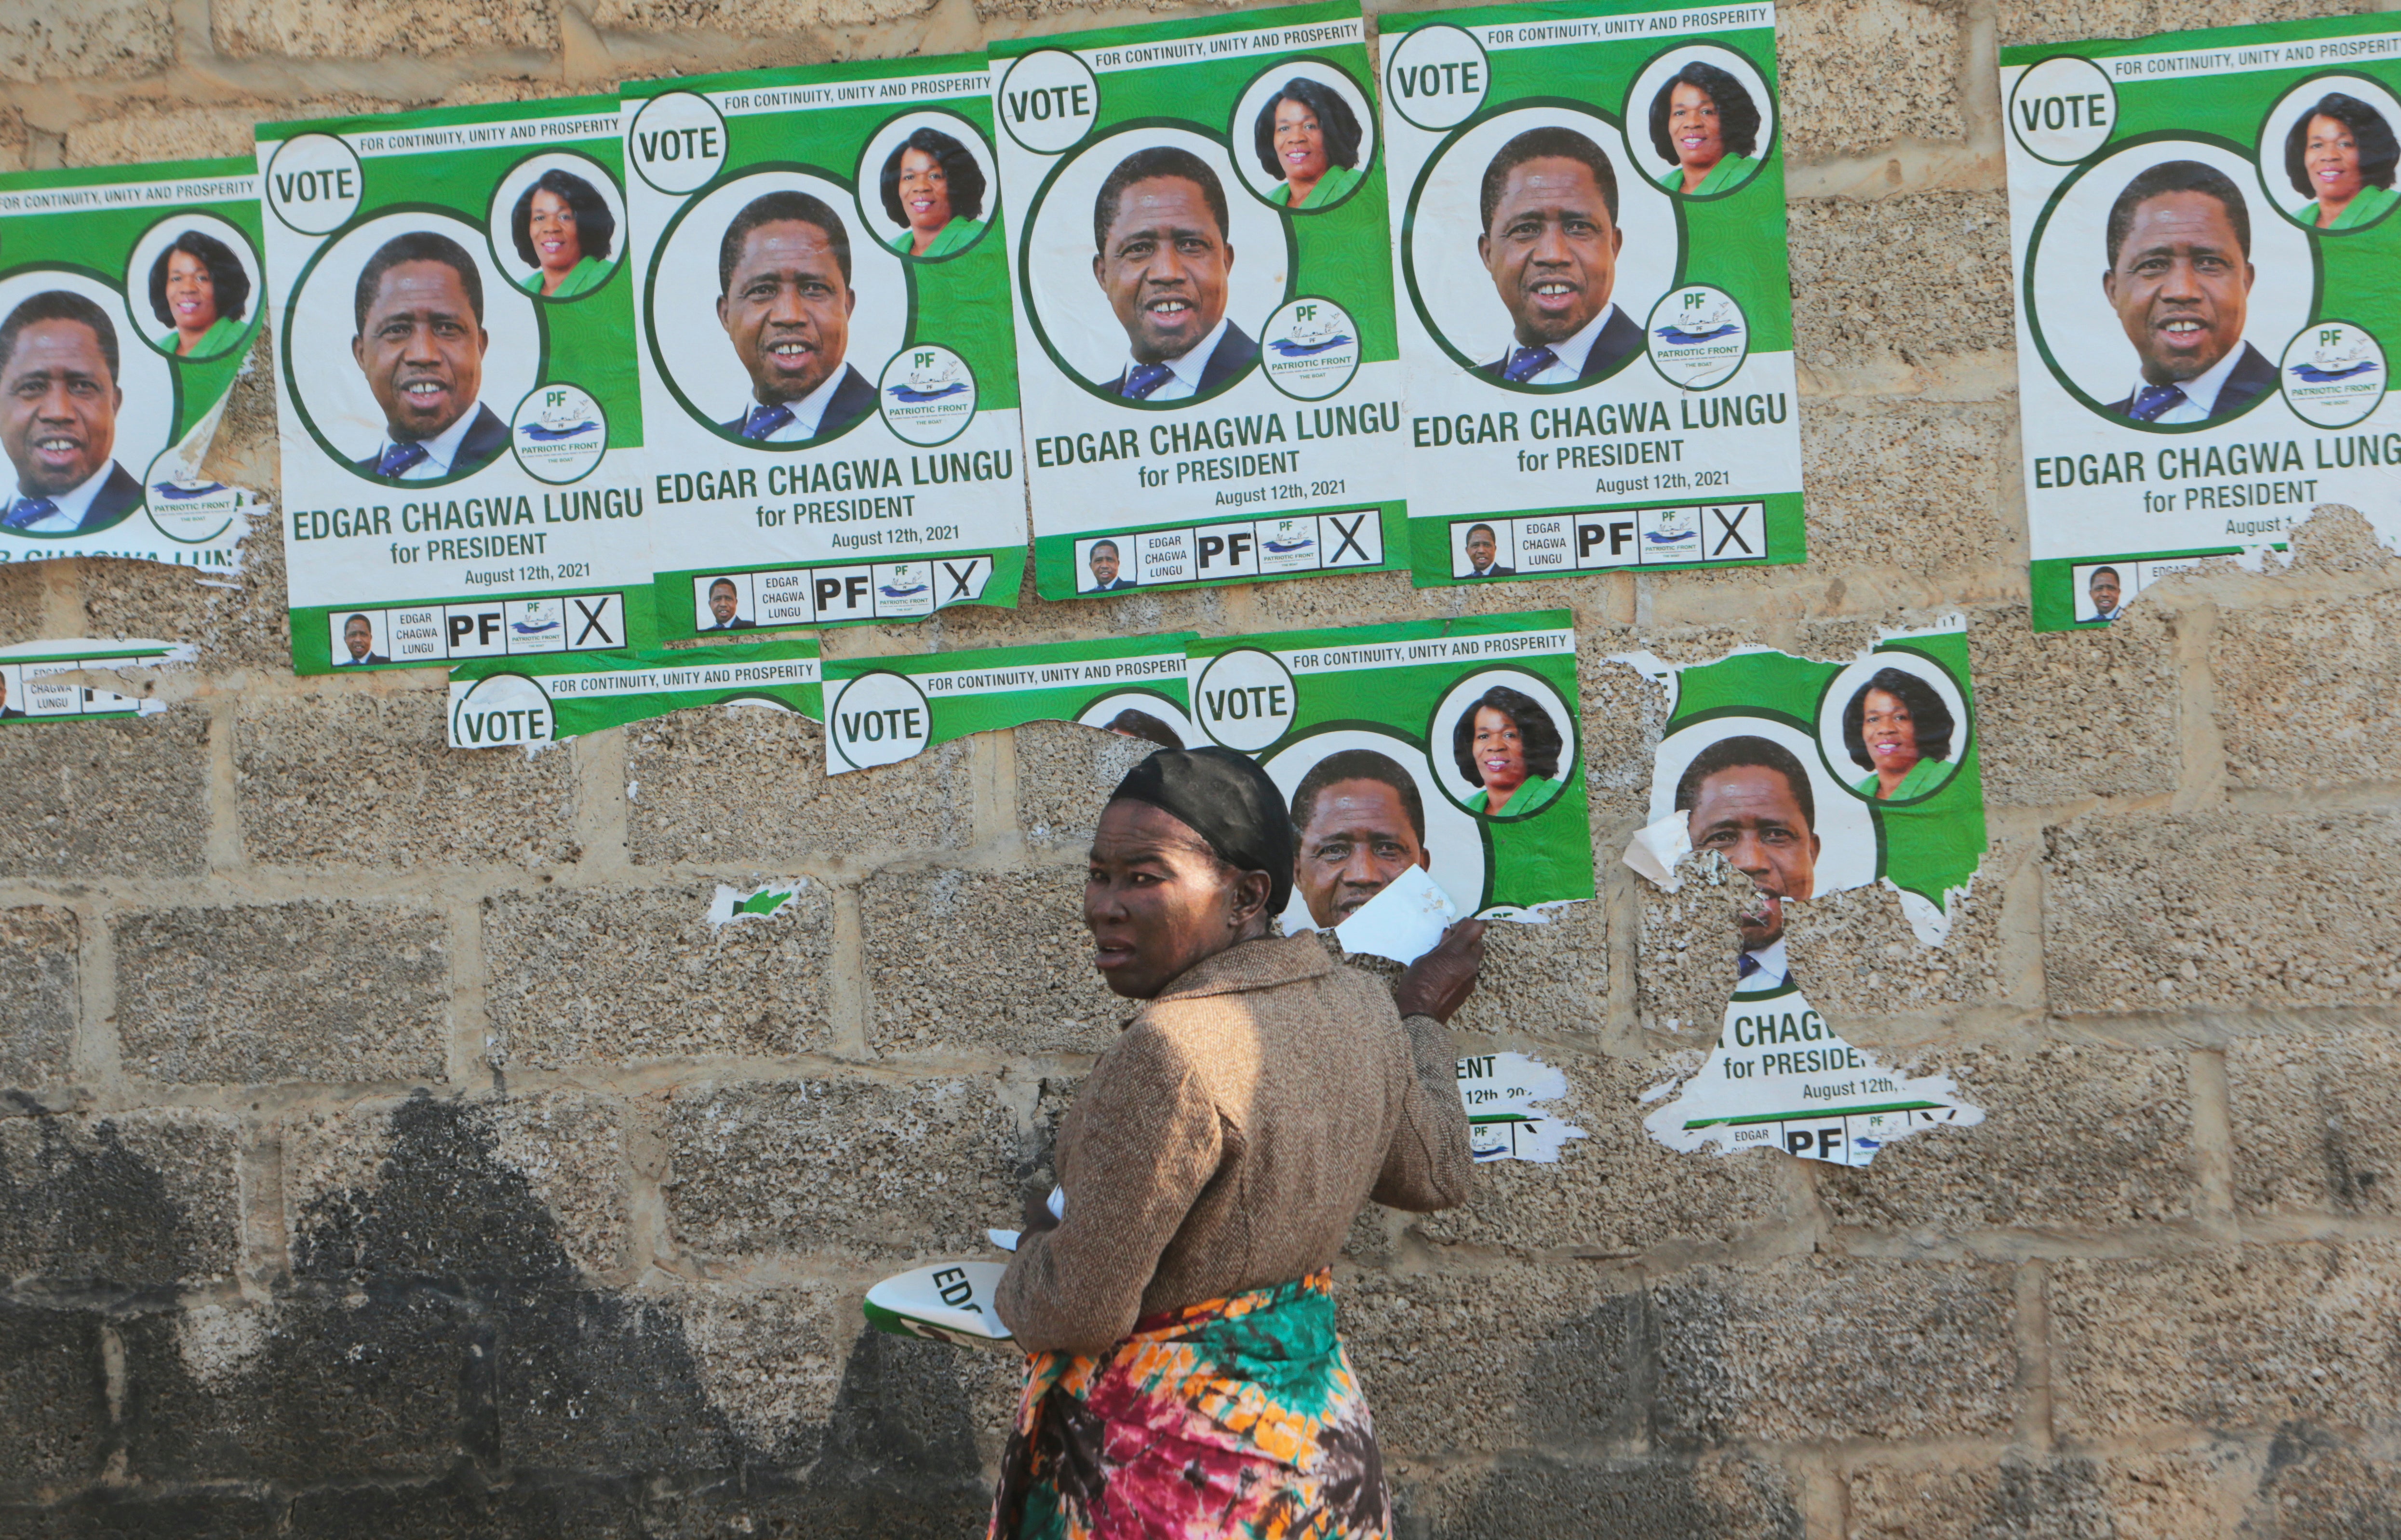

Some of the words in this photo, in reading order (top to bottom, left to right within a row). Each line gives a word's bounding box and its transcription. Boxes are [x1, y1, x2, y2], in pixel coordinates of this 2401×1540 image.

[1489, 30, 1513, 43] FOR
[1519, 23, 1600, 41] CONTINUITY,
[1605, 19, 1644, 33] UNITY
[1650, 16, 1677, 30] AND
[1683, 8, 1766, 27] PROSPERITY
[1096, 53, 1120, 66] FOR
[1126, 44, 1206, 63] CONTINUITY,
[1210, 37, 1247, 53] UNITY
[1253, 33, 1279, 48] AND
[1284, 24, 1358, 44] PROSPERITY
[2116, 61, 2141, 75] FOR
[2147, 54, 2233, 72] CONTINUITY,
[2239, 49, 2279, 65] UNITY
[2286, 46, 2314, 60] AND
[2321, 38, 2401, 57] PROSPERIT
[1397, 61, 1479, 97] VOTE
[725, 96, 749, 109] FOR
[754, 89, 833, 107] CONTINUITY,
[838, 86, 874, 100] UNITY
[880, 83, 906, 96] AND
[912, 77, 991, 94] PROSPERITY
[1008, 84, 1089, 122] VOTE
[2020, 94, 2106, 131] VOTE
[361, 137, 383, 150] FOR
[389, 132, 464, 148] CONTINUITY,
[469, 128, 505, 142] UNITY
[511, 125, 536, 138] AND
[541, 118, 618, 135] PROSPERITY
[639, 127, 718, 162] VOTE
[105, 188, 141, 202] UNITY
[146, 187, 171, 199] AND
[176, 181, 253, 197] PROSPERITY
[275, 168, 354, 202] VOTE
[1296, 305, 1316, 321] PF
[1684, 293, 1705, 309] PF
[2320, 329, 2342, 346] PF
[914, 352, 935, 368] PF
[1272, 360, 1318, 370] PATRIOTIC
[1321, 356, 1351, 365] FRONT
[1658, 348, 1705, 358] PATRIOTIC
[1708, 346, 1738, 354] FRONT
[547, 391, 566, 407] PF
[2292, 386, 2341, 395] PATRIOTIC
[889, 406, 935, 415] PATRIOTIC
[1413, 412, 1519, 447] EDGAR
[1531, 401, 1671, 439] CHAGWA
[1681, 393, 1786, 429] LUNGU
[1036, 429, 1140, 467] EDGAR
[1150, 413, 1286, 455] CHAGWA
[1296, 401, 1399, 440] LUNGU
[522, 444, 566, 454] PATRIOTIC
[569, 442, 598, 450] FRONT
[1517, 450, 1548, 471] for
[1557, 440, 1684, 469] PRESIDENT
[657, 469, 757, 504] EDGAR
[769, 458, 902, 495] CHAGWA
[912, 449, 1012, 485] LUNGU
[1139, 466, 1168, 487] for
[1177, 450, 1299, 483] PRESIDENT
[2035, 452, 2145, 488] EDGAR
[2158, 441, 2304, 480] CHAGWA
[1216, 487, 1266, 506] August
[1271, 484, 1307, 499] 12th,
[1312, 480, 1344, 495] 2021
[1596, 476, 1649, 495] August
[1654, 473, 1690, 489] 12th,
[1695, 471, 1728, 486] 2021
[154, 503, 199, 512] PATRIOTIC
[201, 501, 230, 509] FRONT
[2143, 491, 2176, 512] for
[2185, 480, 2317, 509] PRESIDENT
[293, 506, 391, 540] EDGAR
[402, 495, 534, 532] CHAGWA
[544, 488, 643, 522] LUNGU
[756, 506, 786, 527] for
[794, 495, 914, 524] PRESIDENT
[1662, 511, 1675, 522] PF
[832, 531, 882, 549] August
[887, 528, 922, 544] 12th,
[926, 525, 958, 540] 2021
[1279, 521, 1292, 531] PF
[1527, 522, 1560, 534] EDGAR
[2226, 517, 2280, 536] August
[390, 543, 419, 563] for
[428, 533, 547, 561] PRESIDENT
[1149, 536, 1180, 548] EDGAR
[1199, 532, 1251, 568] PF
[1523, 538, 1566, 550] CHAGWA
[1578, 522, 1633, 557] PF
[1145, 550, 1186, 564] CHAGWA
[1529, 554, 1561, 565] LUNGU
[465, 568, 514, 586] August
[519, 565, 553, 581] 12th,
[558, 562, 589, 577] 2021
[766, 576, 798, 588] EDGAR
[895, 565, 908, 576] PF
[1151, 565, 1182, 577] LUNGU
[763, 591, 804, 603] CHAGWA
[816, 576, 868, 611] PF
[400, 613, 431, 624] EDGAR
[527, 602, 539, 612] PF
[769, 607, 800, 618] LUNGU
[397, 628, 437, 640] CHAGWA
[448, 614, 501, 647] PF
[403, 643, 433, 654] LUNGU
[1294, 655, 1318, 668] FOR
[1324, 648, 1404, 665] CONTINUITY,
[1409, 644, 1447, 658] UNITY
[1452, 642, 1479, 655] AND
[1485, 635, 1566, 652] PROSPERITY
[553, 680, 576, 692] FOR
[581, 674, 658, 690] CONTINUITY,
[663, 672, 699, 685] UNITY
[705, 670, 729, 683] AND
[736, 664, 812, 681] PROSPERITY
[928, 678, 952, 691] FOR
[958, 671, 1037, 688] CONTINUITY,
[1042, 668, 1079, 682] UNITY
[1085, 666, 1111, 678] AND
[37, 698, 67, 708] LUNGU
[1205, 685, 1287, 721] VOTE
[464, 709, 545, 742] VOTE
[841, 708, 922, 742] VOTE
[1735, 1010, 1835, 1047] CHAG
[1723, 1058, 1754, 1079] for
[1762, 1047, 1865, 1076] PRESIDE
[1803, 1081, 1855, 1100] August
[1860, 1077, 1898, 1094] 12th,
[1474, 1126, 1488, 1137] PF
[1870, 1116, 1883, 1126] PF
[1735, 1129, 1769, 1141] EDGAR
